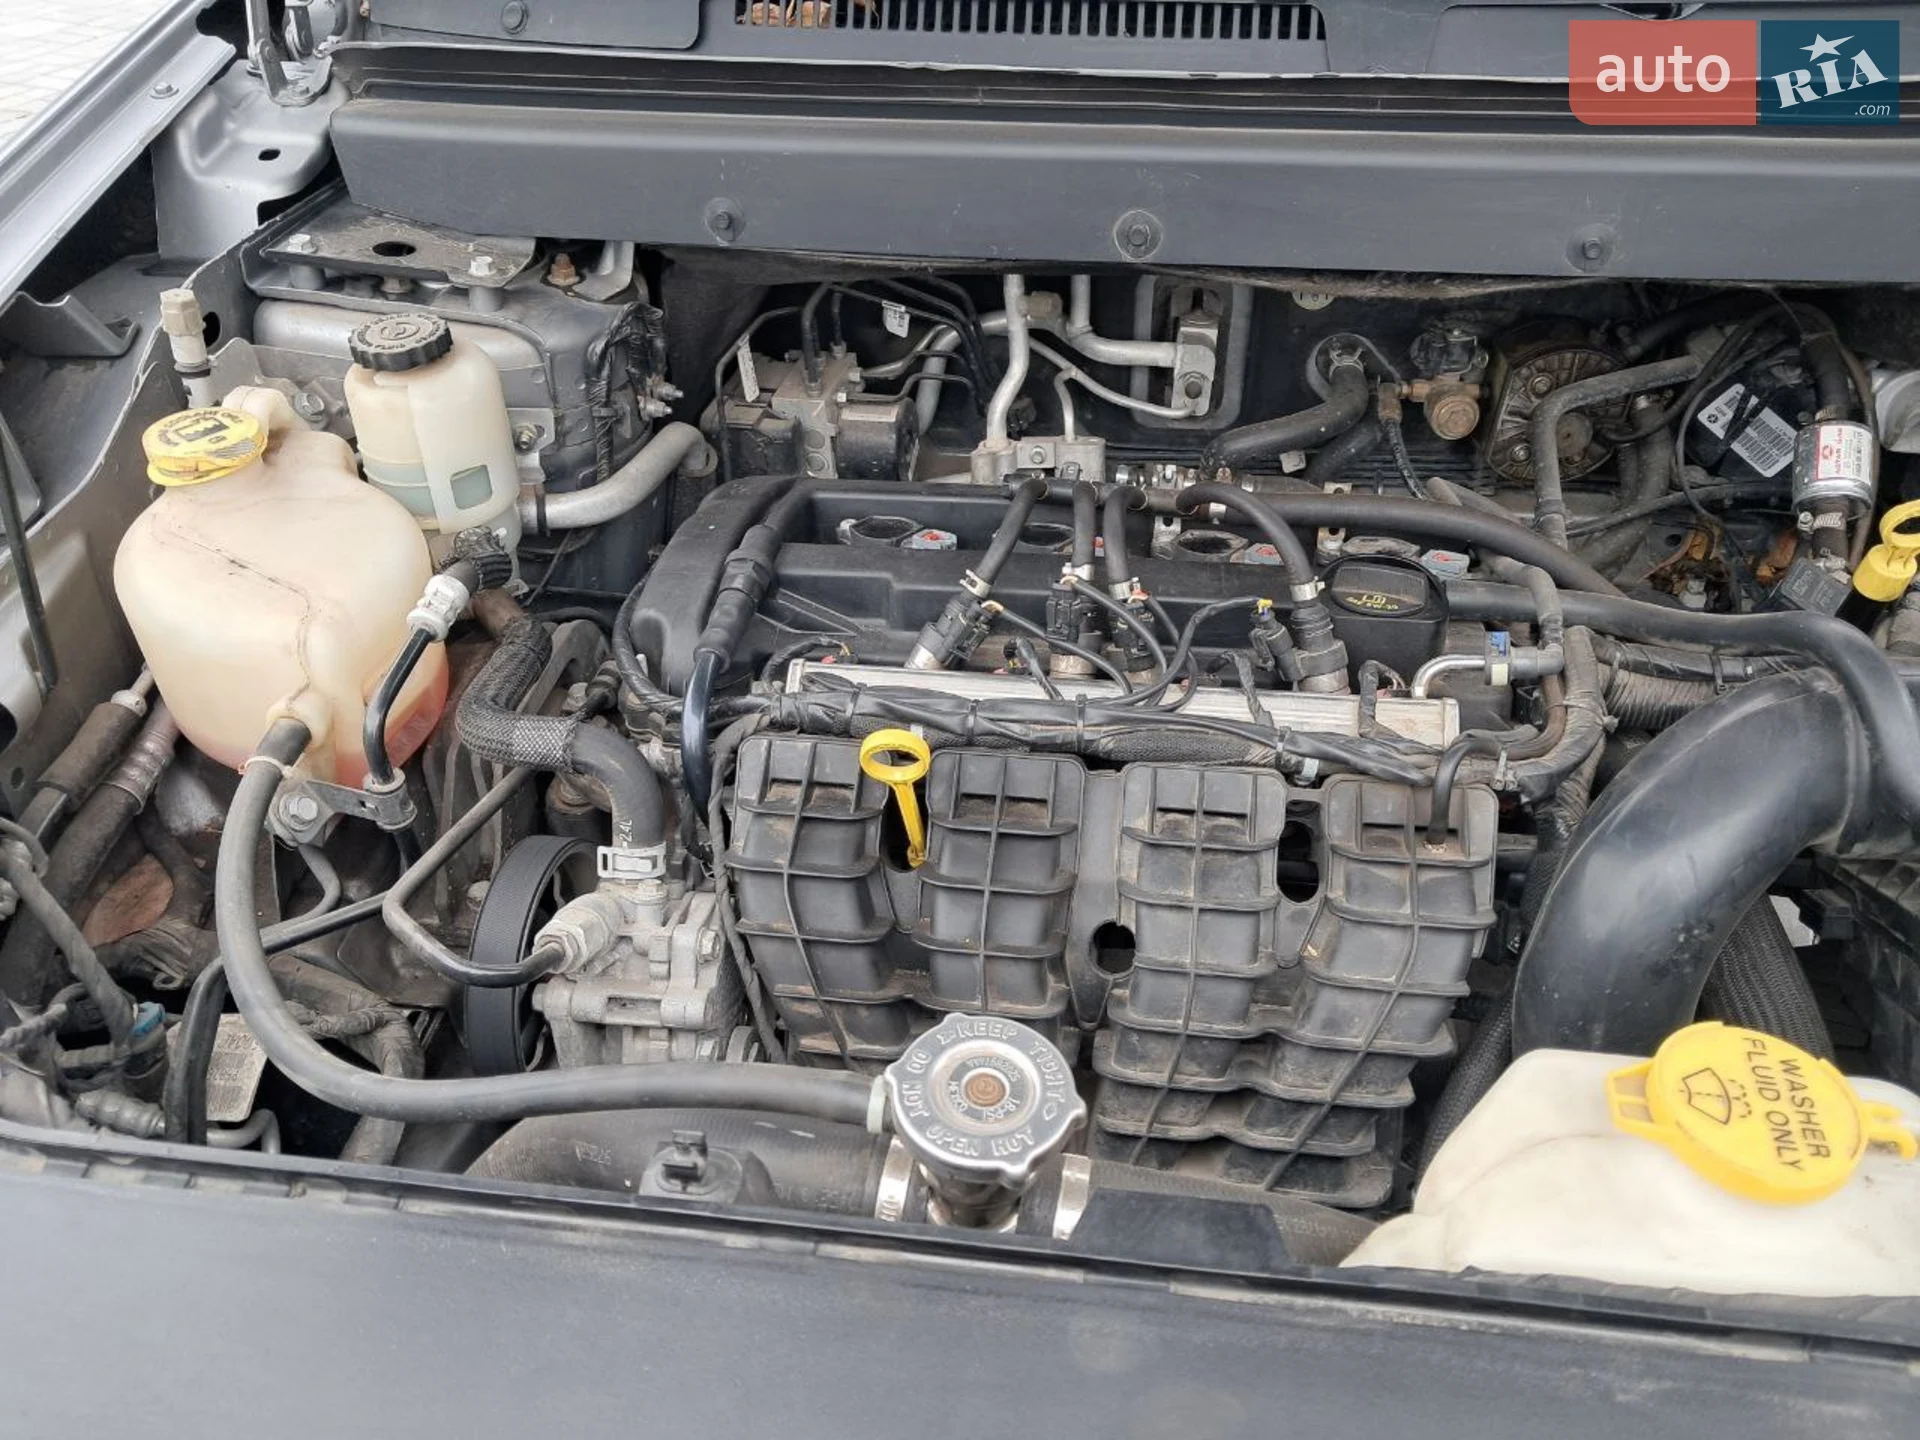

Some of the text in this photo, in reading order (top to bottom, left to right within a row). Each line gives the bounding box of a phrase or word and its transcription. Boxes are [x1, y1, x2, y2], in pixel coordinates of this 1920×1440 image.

[906, 1049, 933, 1074] DO
[956, 1022, 1018, 1040] KEEP
[1029, 1041, 1066, 1103] TIGHT
[903, 1081, 930, 1118] NOT
[1741, 1037, 1805, 1172] FLUID ONLY
[1779, 1058, 1831, 1158] WASHER
[926, 1125, 981, 1157] OPEN
[991, 1129, 1035, 1157] HOT
